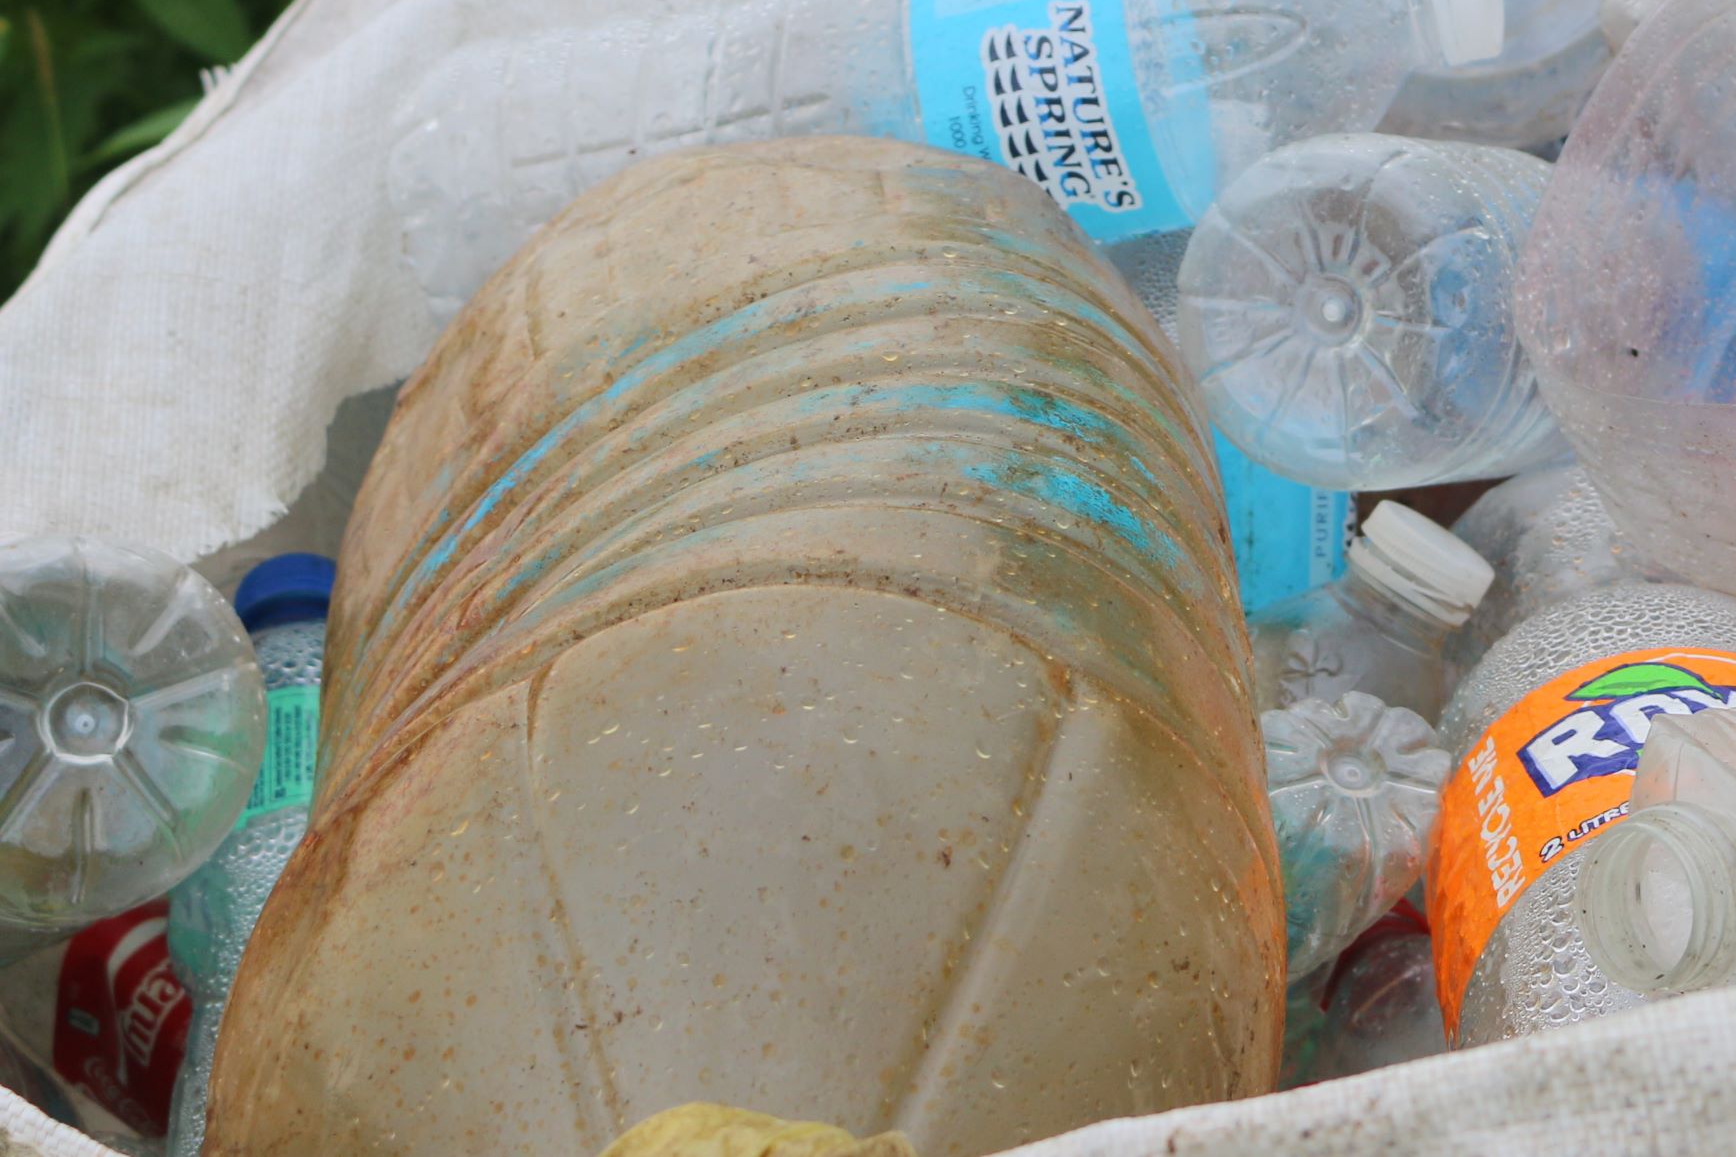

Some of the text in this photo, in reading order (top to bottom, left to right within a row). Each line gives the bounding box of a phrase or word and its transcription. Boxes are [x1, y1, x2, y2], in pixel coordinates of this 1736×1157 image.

[948, 115, 967, 149] 1000
[962, 85, 994, 162] Drinking W
[1024, 34, 1092, 199] SPRING
[1056, 4, 1136, 210] NATURE'S
[1467, 735, 1526, 909] RECYCLE ME
[1539, 835, 1565, 864] 2
